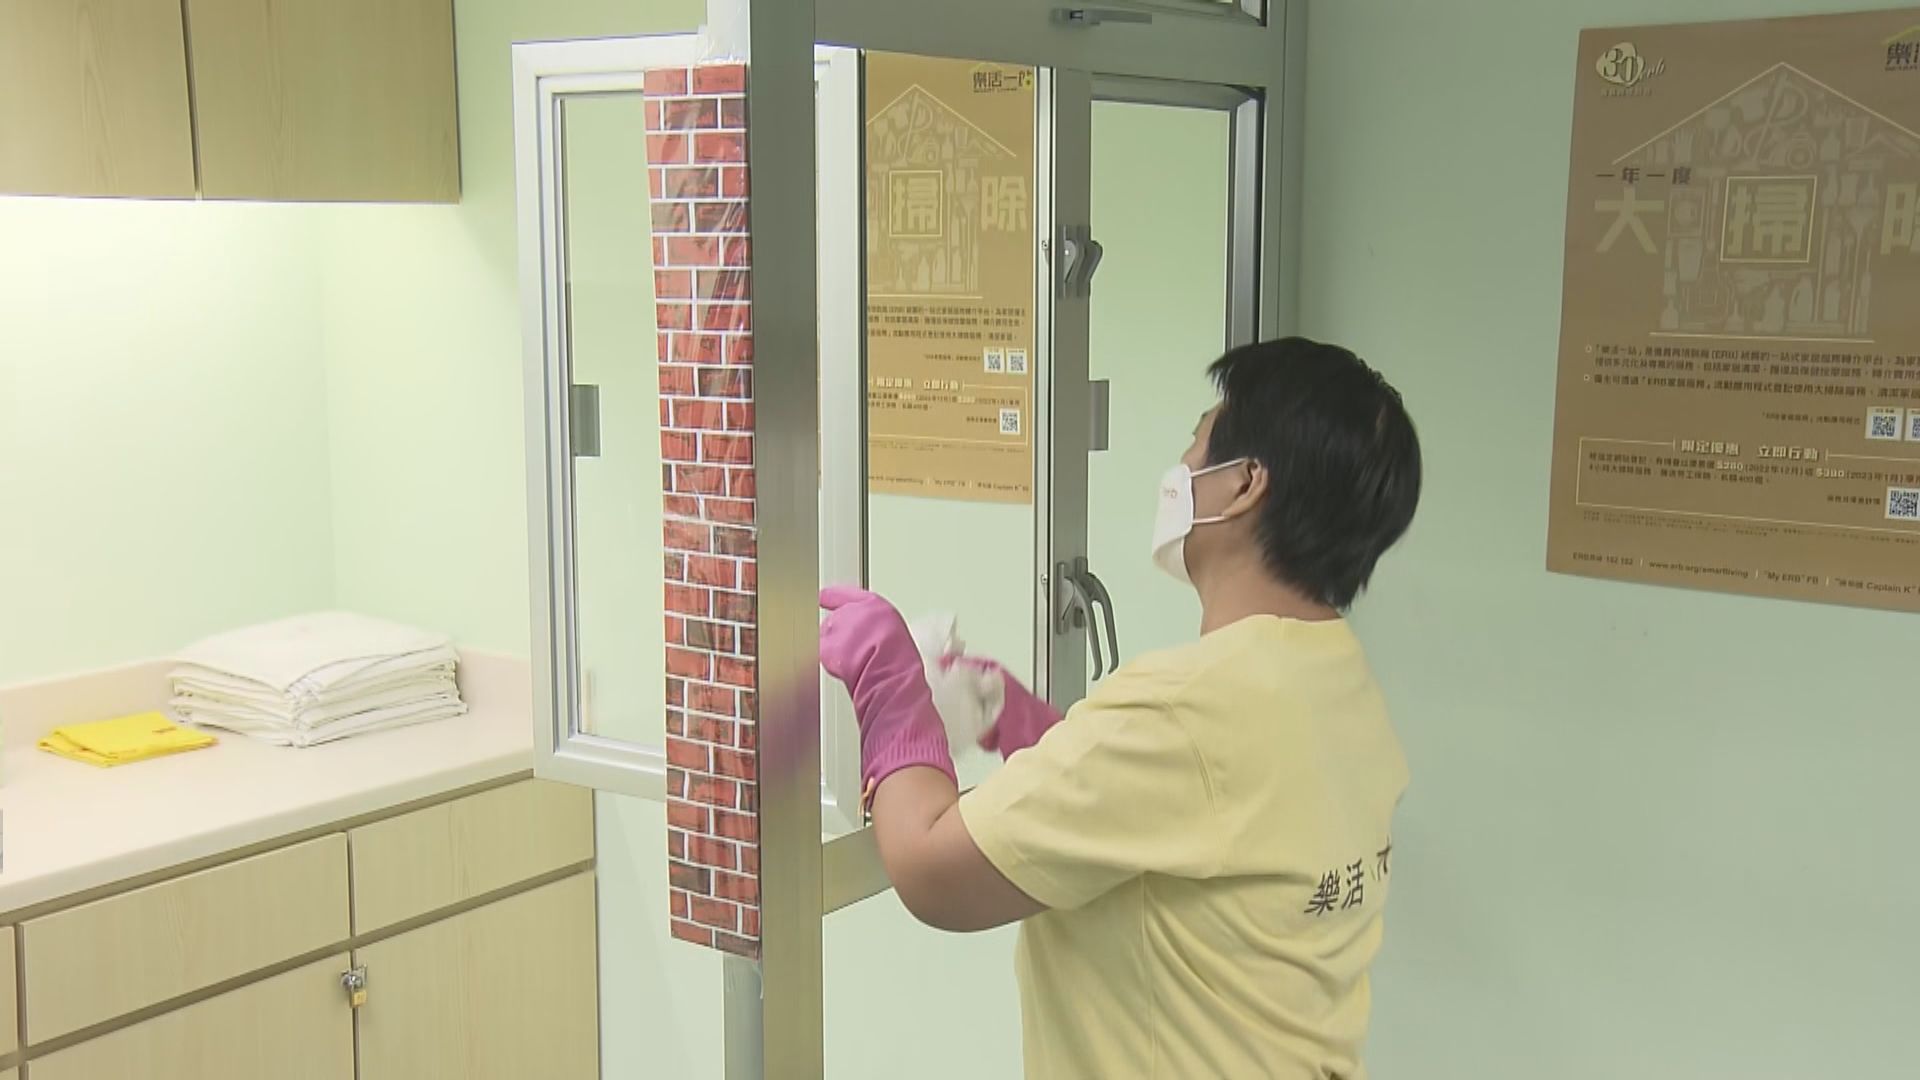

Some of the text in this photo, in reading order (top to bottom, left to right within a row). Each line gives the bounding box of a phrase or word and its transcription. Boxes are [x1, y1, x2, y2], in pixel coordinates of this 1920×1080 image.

[1595, 166, 1692, 186] 一年一度
[1681, 439, 1819, 461] 限定優惠 立即行動
